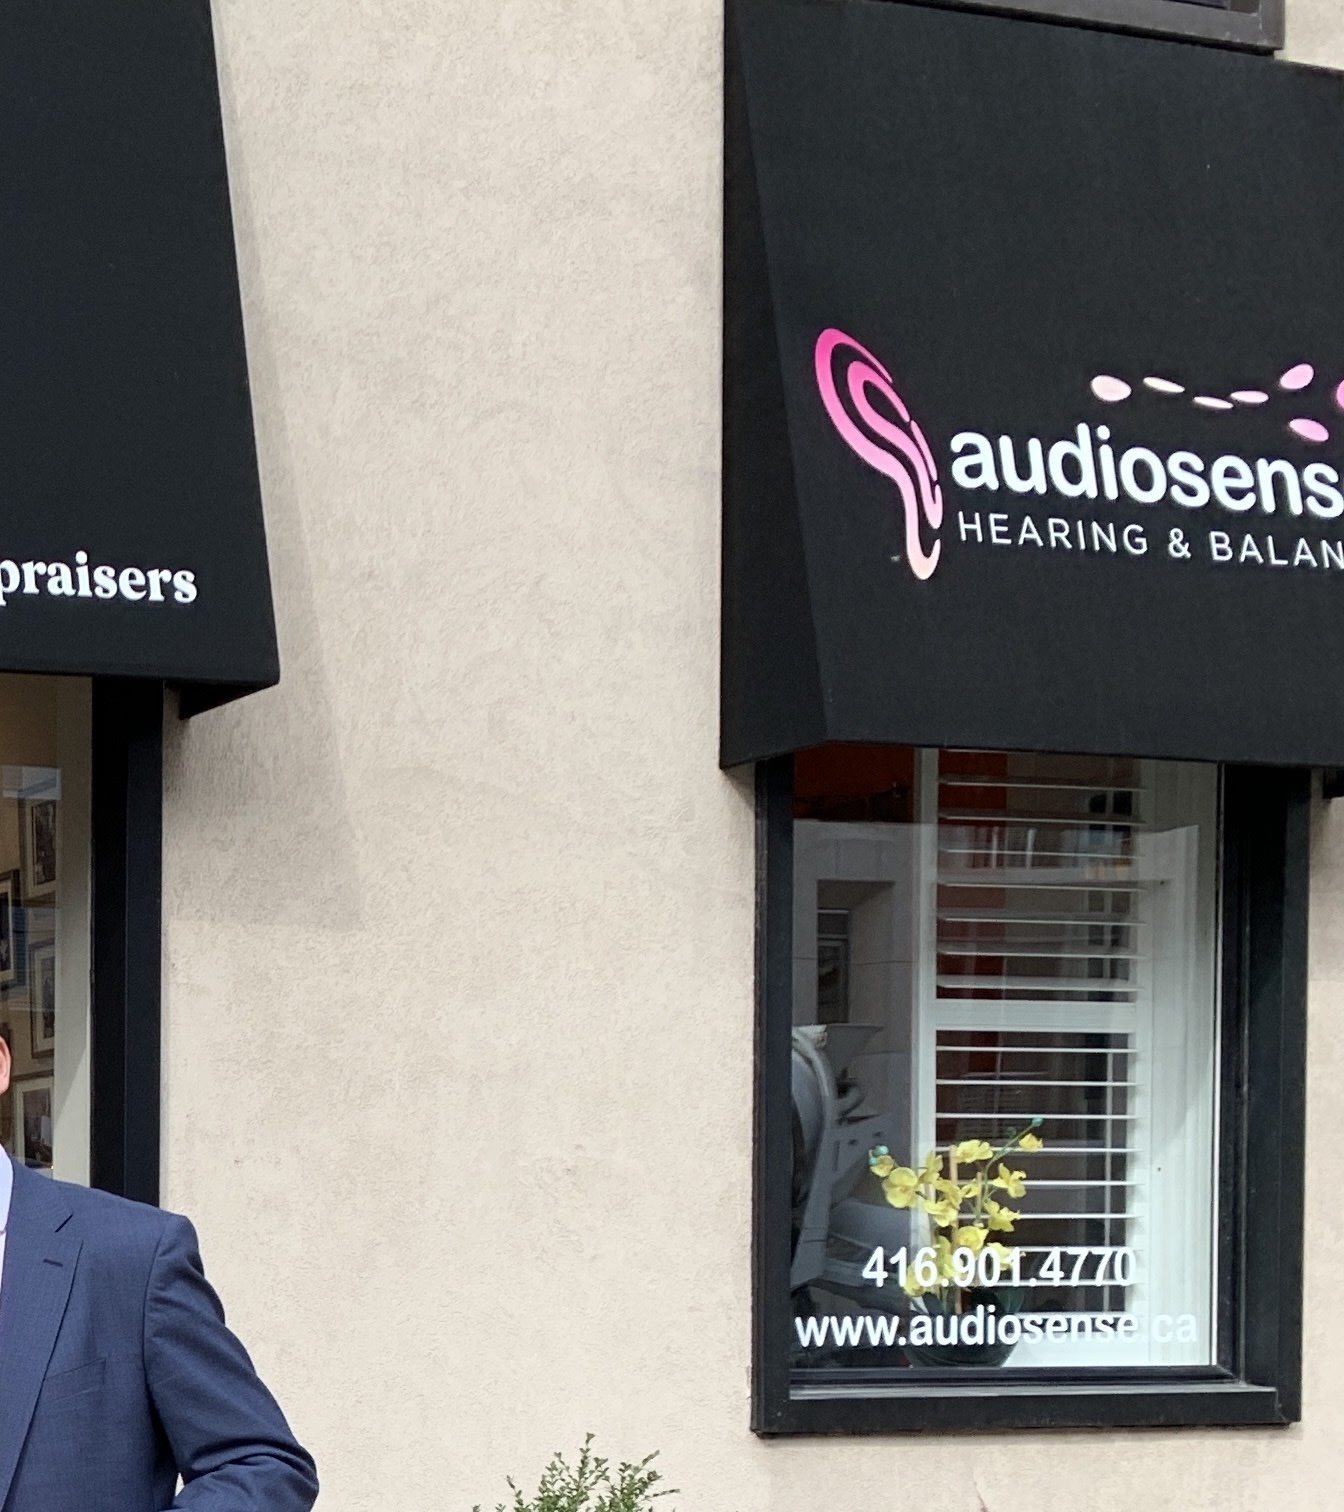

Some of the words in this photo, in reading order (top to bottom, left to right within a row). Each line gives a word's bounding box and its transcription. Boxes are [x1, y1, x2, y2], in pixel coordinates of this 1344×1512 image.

[958, 510, 1148, 555] HEARING
[1168, 527, 1192, 559] &
[1209, 530, 1344, 570] BALAN
[862, 1246, 1137, 1288] 416.901.4770
[794, 1304, 1198, 1348] www.audiosense.ca
